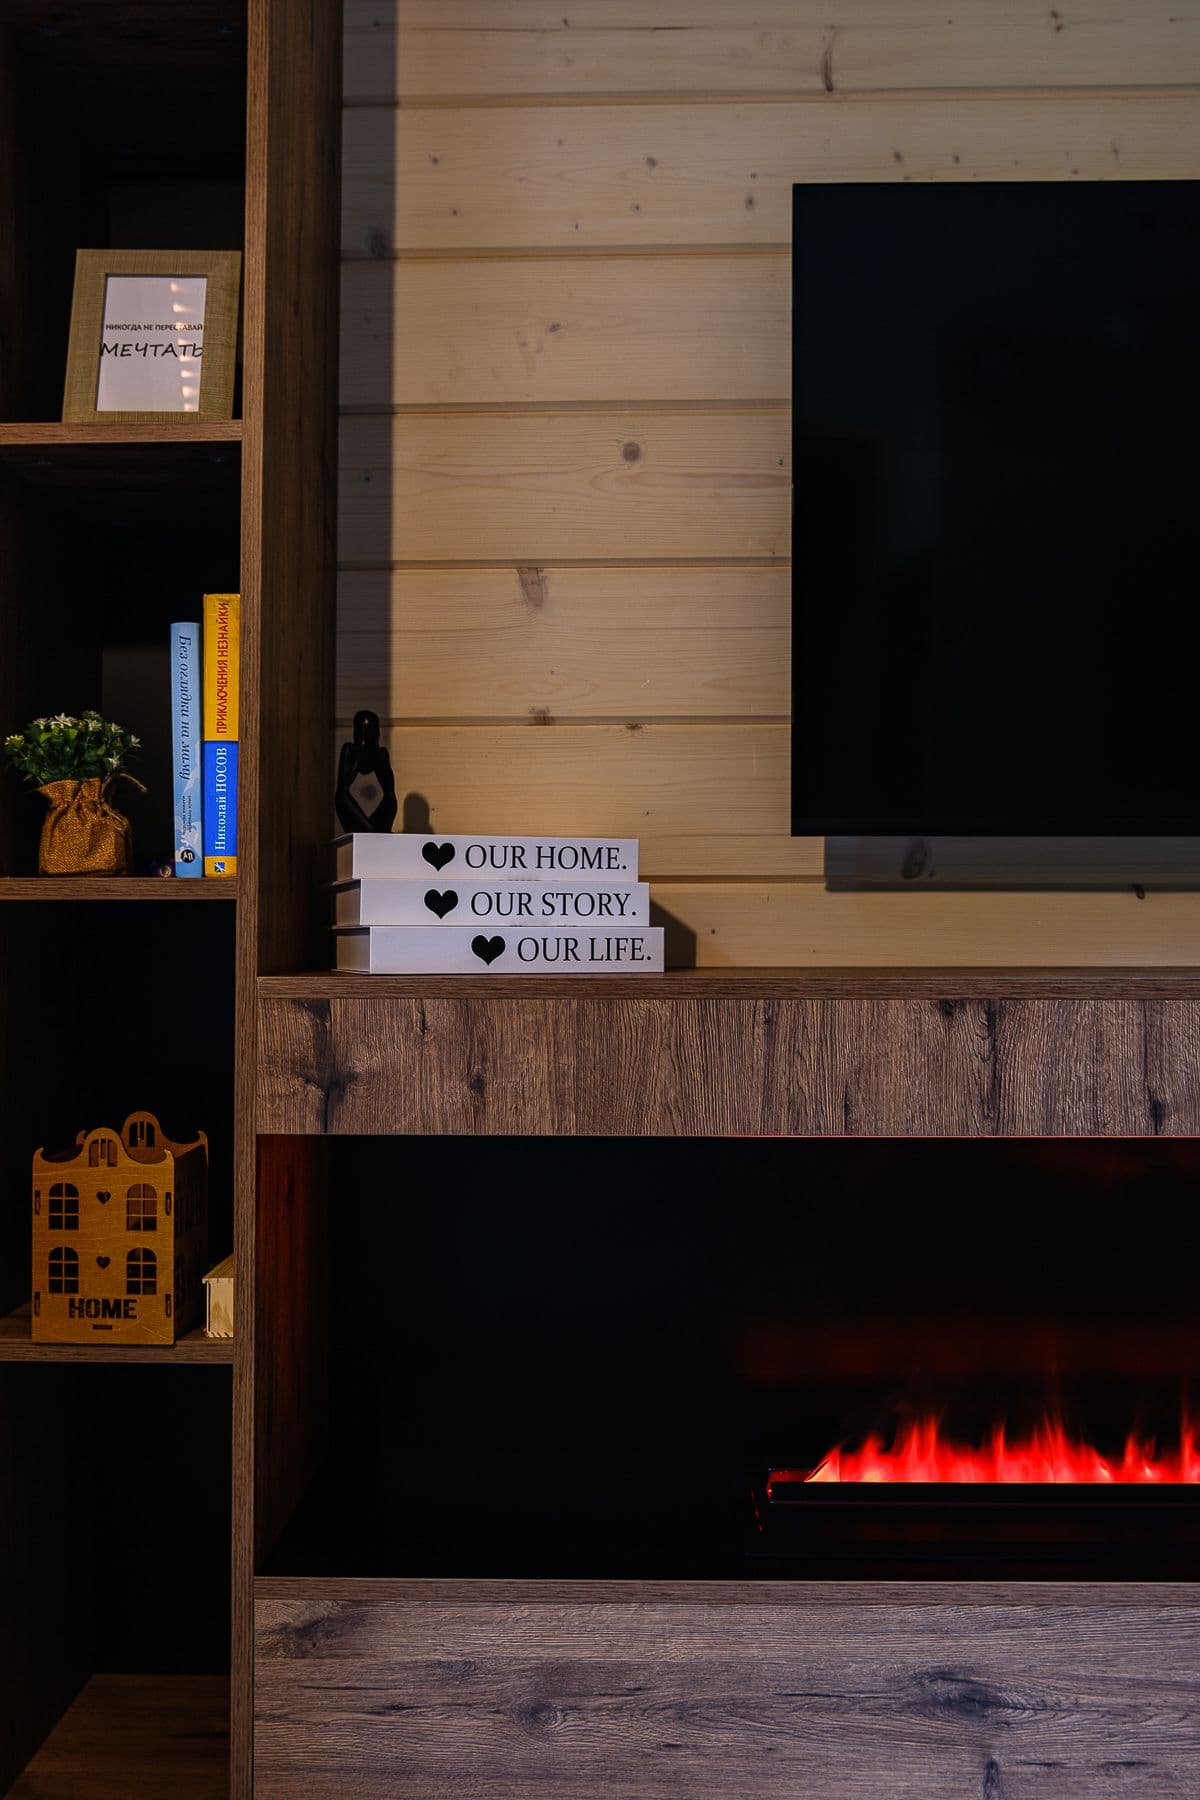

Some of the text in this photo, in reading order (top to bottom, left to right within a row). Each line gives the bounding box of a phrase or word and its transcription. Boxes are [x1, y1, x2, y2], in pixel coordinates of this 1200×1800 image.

[105, 323, 142, 331] НИКОГДА
[143, 323, 153, 331] НЕ
[100, 343, 203, 358] МЕЧТАТЬ
[215, 600, 230, 734] ПРИКЛЮЧЕНИЯ НЕЗНАЙКИ
[179, 635, 193, 780] Без оглядки на маму
[214, 747, 228, 851] Николай НОСОВ
[465, 844, 627, 870] OUR HOME.
[471, 891, 637, 917] OUR STORY.
[517, 937, 652, 962] OUR LIFE.
[69, 1298, 137, 1319] HOME
